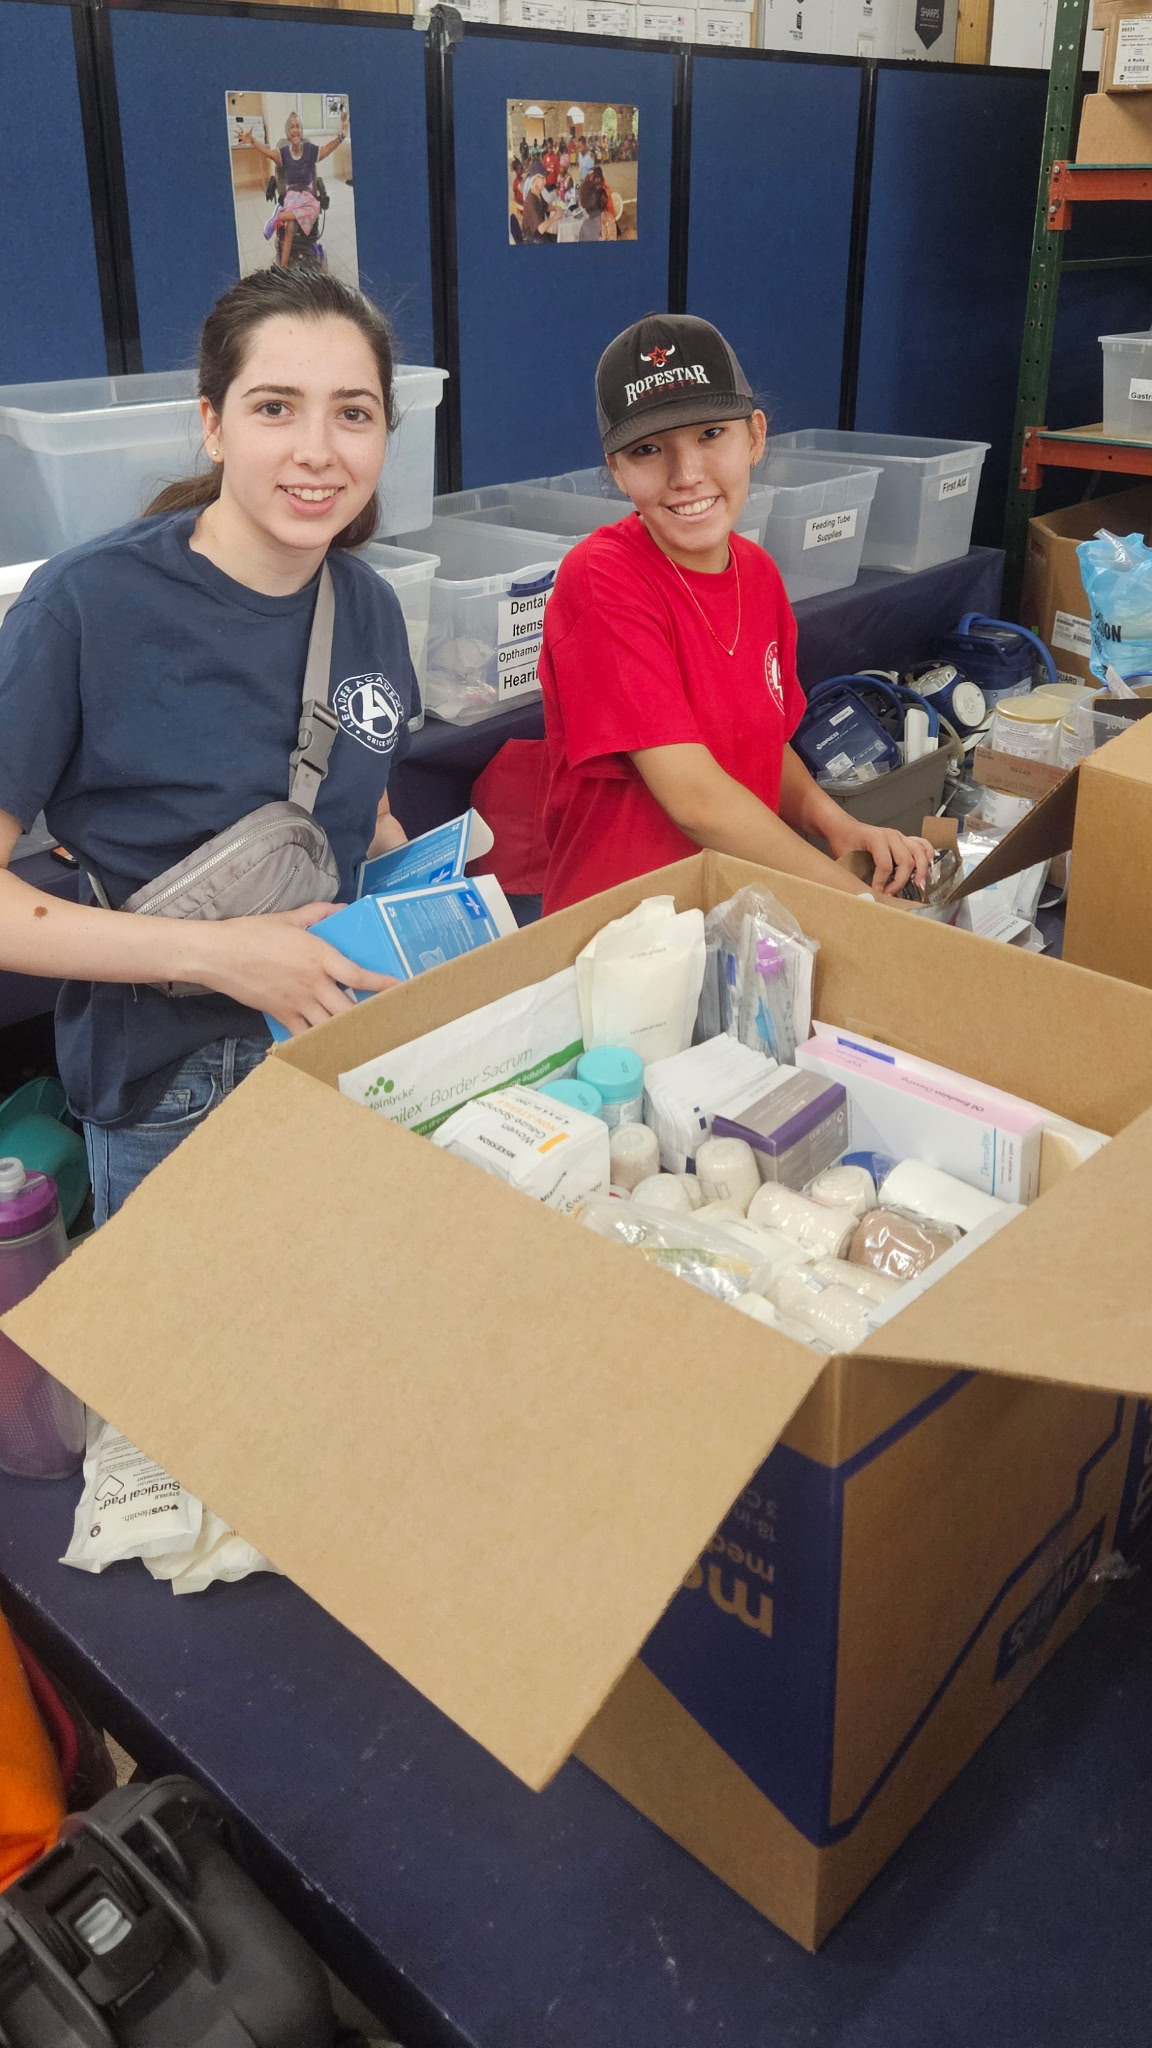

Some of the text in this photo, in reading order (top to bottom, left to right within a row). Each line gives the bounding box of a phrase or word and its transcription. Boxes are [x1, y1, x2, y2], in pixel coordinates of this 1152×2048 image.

[920, 6, 940, 19] SHARPS
[624, 364, 711, 407] ROPESTAR
[639, 378, 696, 399] EVENTS
[1130, 391, 1152, 401] Gastr
[942, 477, 967, 493] First Aid
[812, 514, 851, 531] Feeding Tube
[817, 529, 842, 543] Supplies
[512, 619, 543, 637] Items
[499, 642, 543, 663] Opthamol
[337, 685, 355, 728] LEADER
[355, 676, 404, 717] ACADEMY
[430, 1075, 480, 1108] Border
[481, 1047, 533, 1083] Sacrum
[934, 1089, 971, 1108] Emulsion
[971, 1103, 985, 1112] Oil
[501, 1121, 535, 1147] Woven
[514, 1117, 546, 1139] Gauze
[130, 1481, 181, 1502] Surgical
[154, 1491, 181, 1501] STERILE
